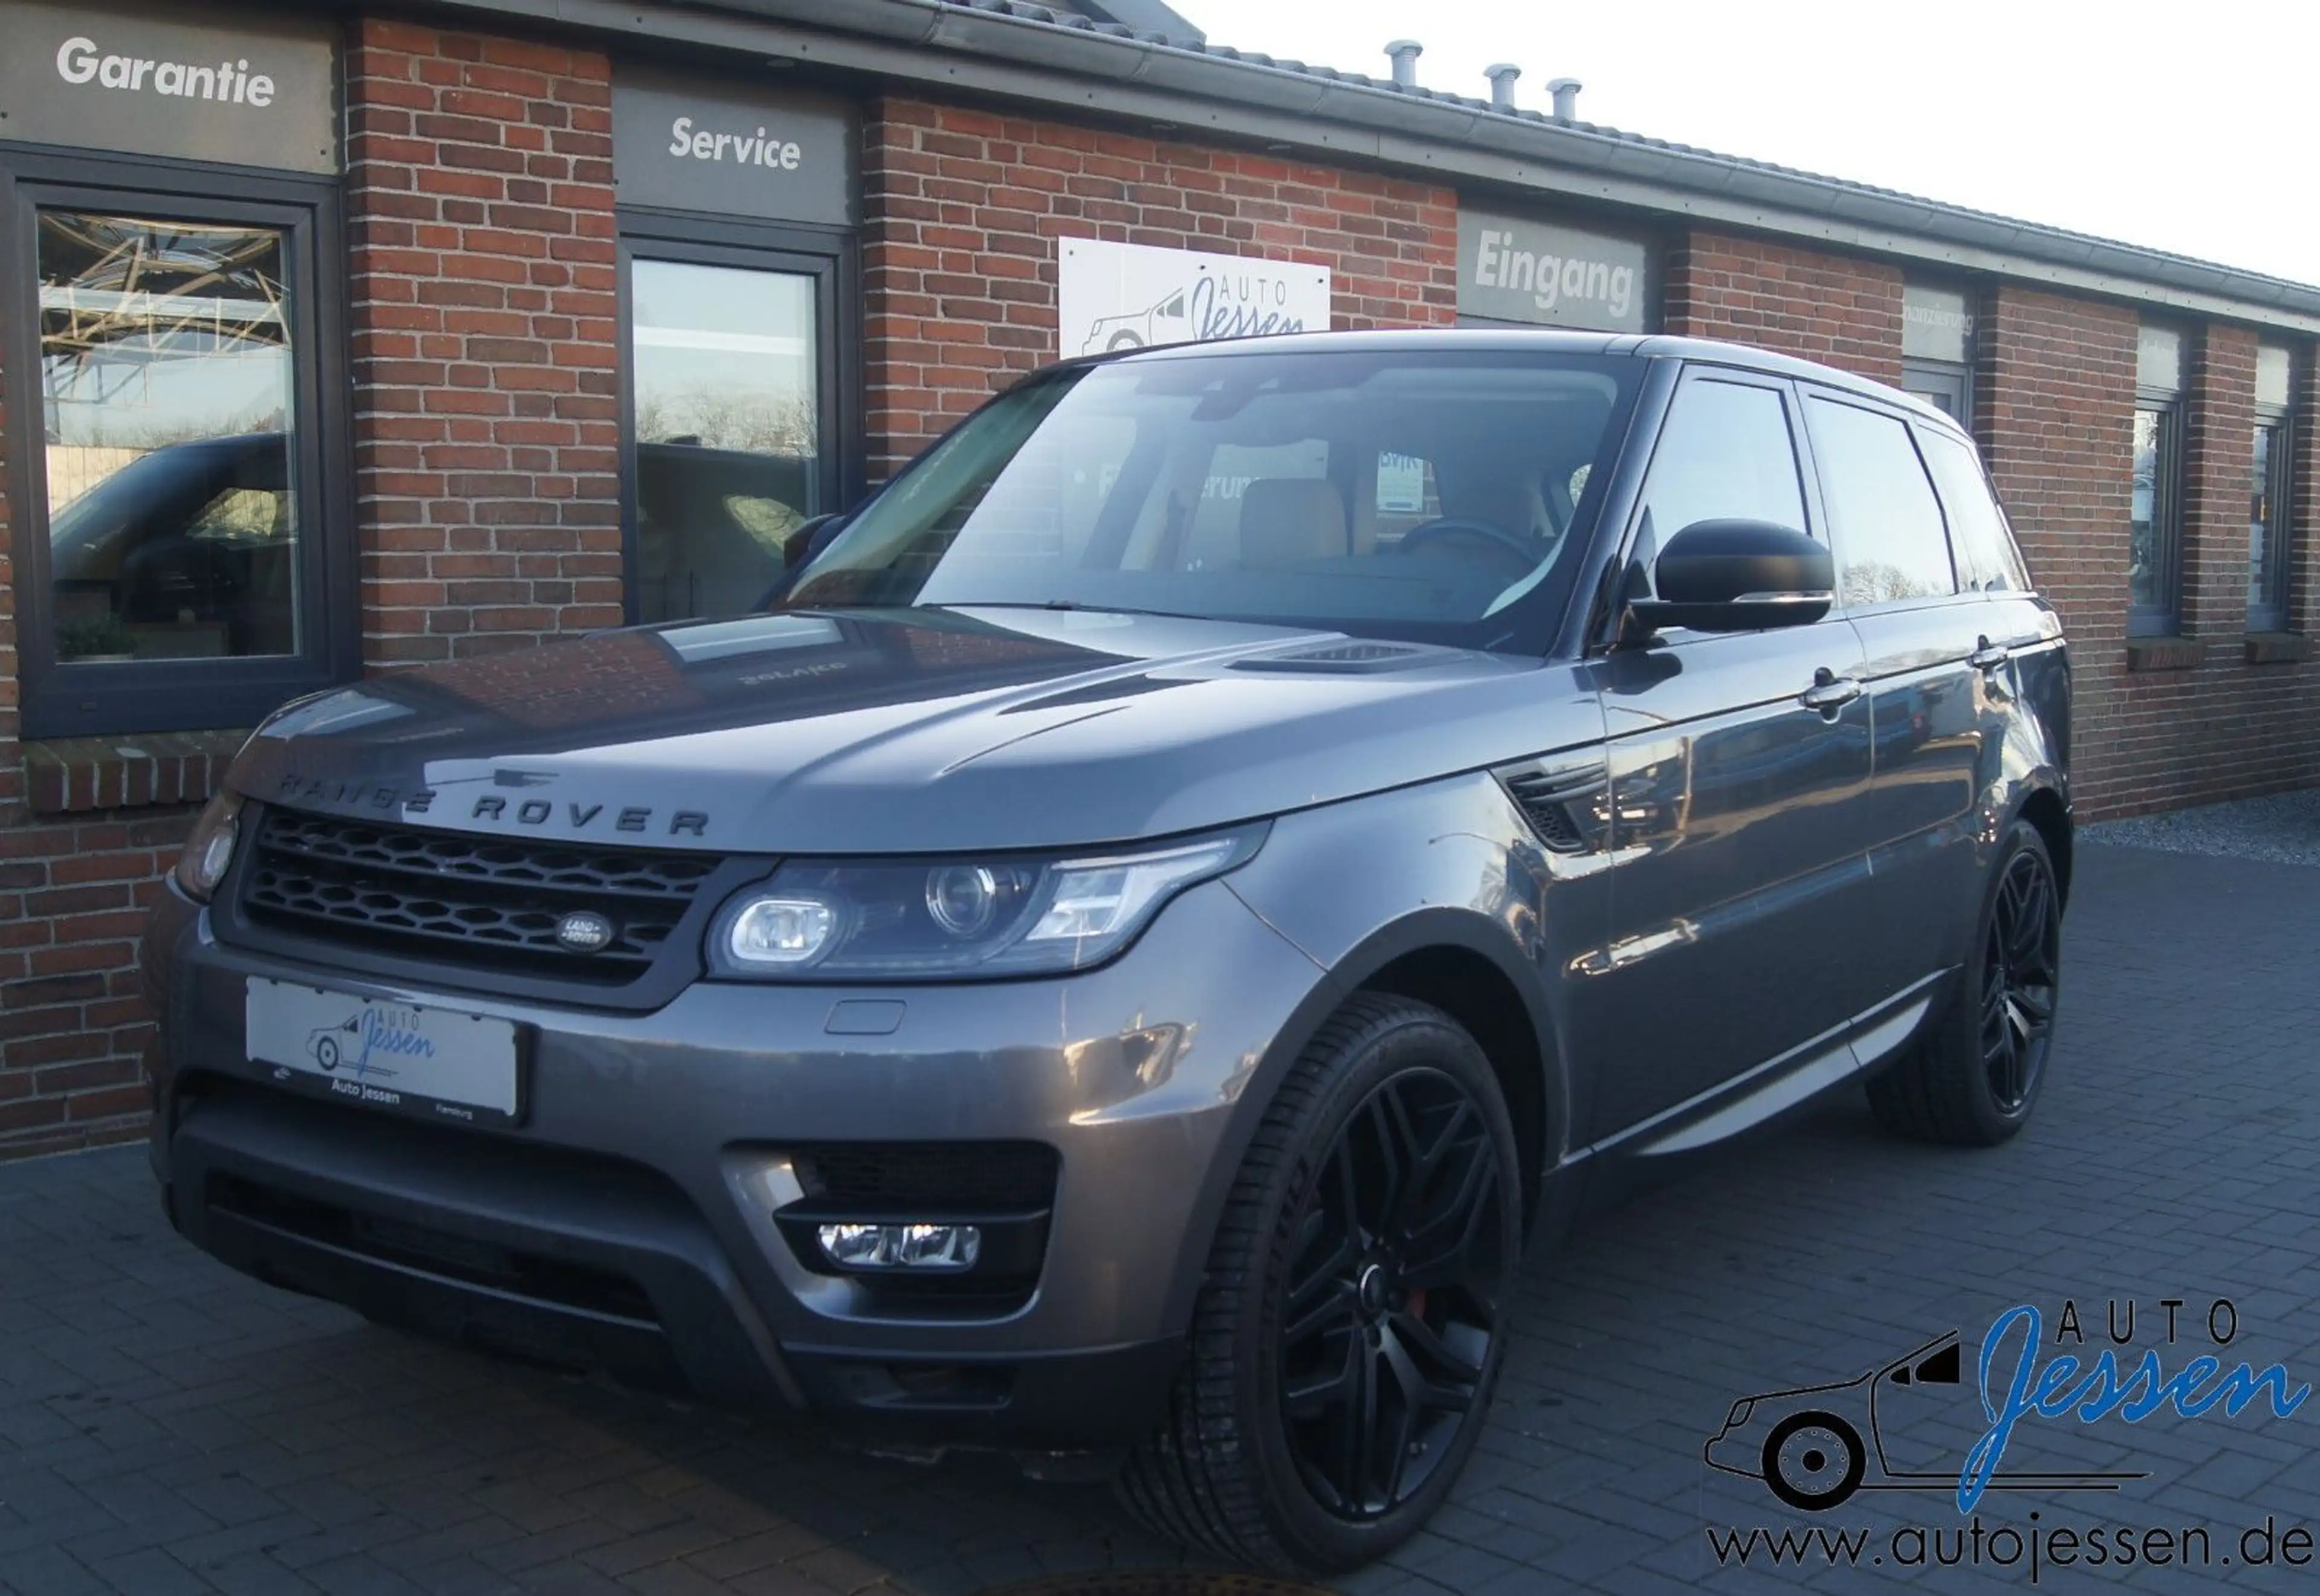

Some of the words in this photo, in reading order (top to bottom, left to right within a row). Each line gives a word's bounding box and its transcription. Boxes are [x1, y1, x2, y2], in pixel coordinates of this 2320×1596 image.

[57, 36, 275, 107] Garantie
[669, 117, 801, 170] Service
[1219, 274, 1286, 306] AUTO
[1475, 230, 1633, 318] Eingang
[281, 773, 436, 813] RANGE
[471, 795, 709, 836] ROVER
[358, 1008, 436, 1078] Jessen
[377, 1010, 420, 1031] AUTO
[330, 1078, 360, 1096] Auto
[361, 1083, 401, 1105] Jessen
